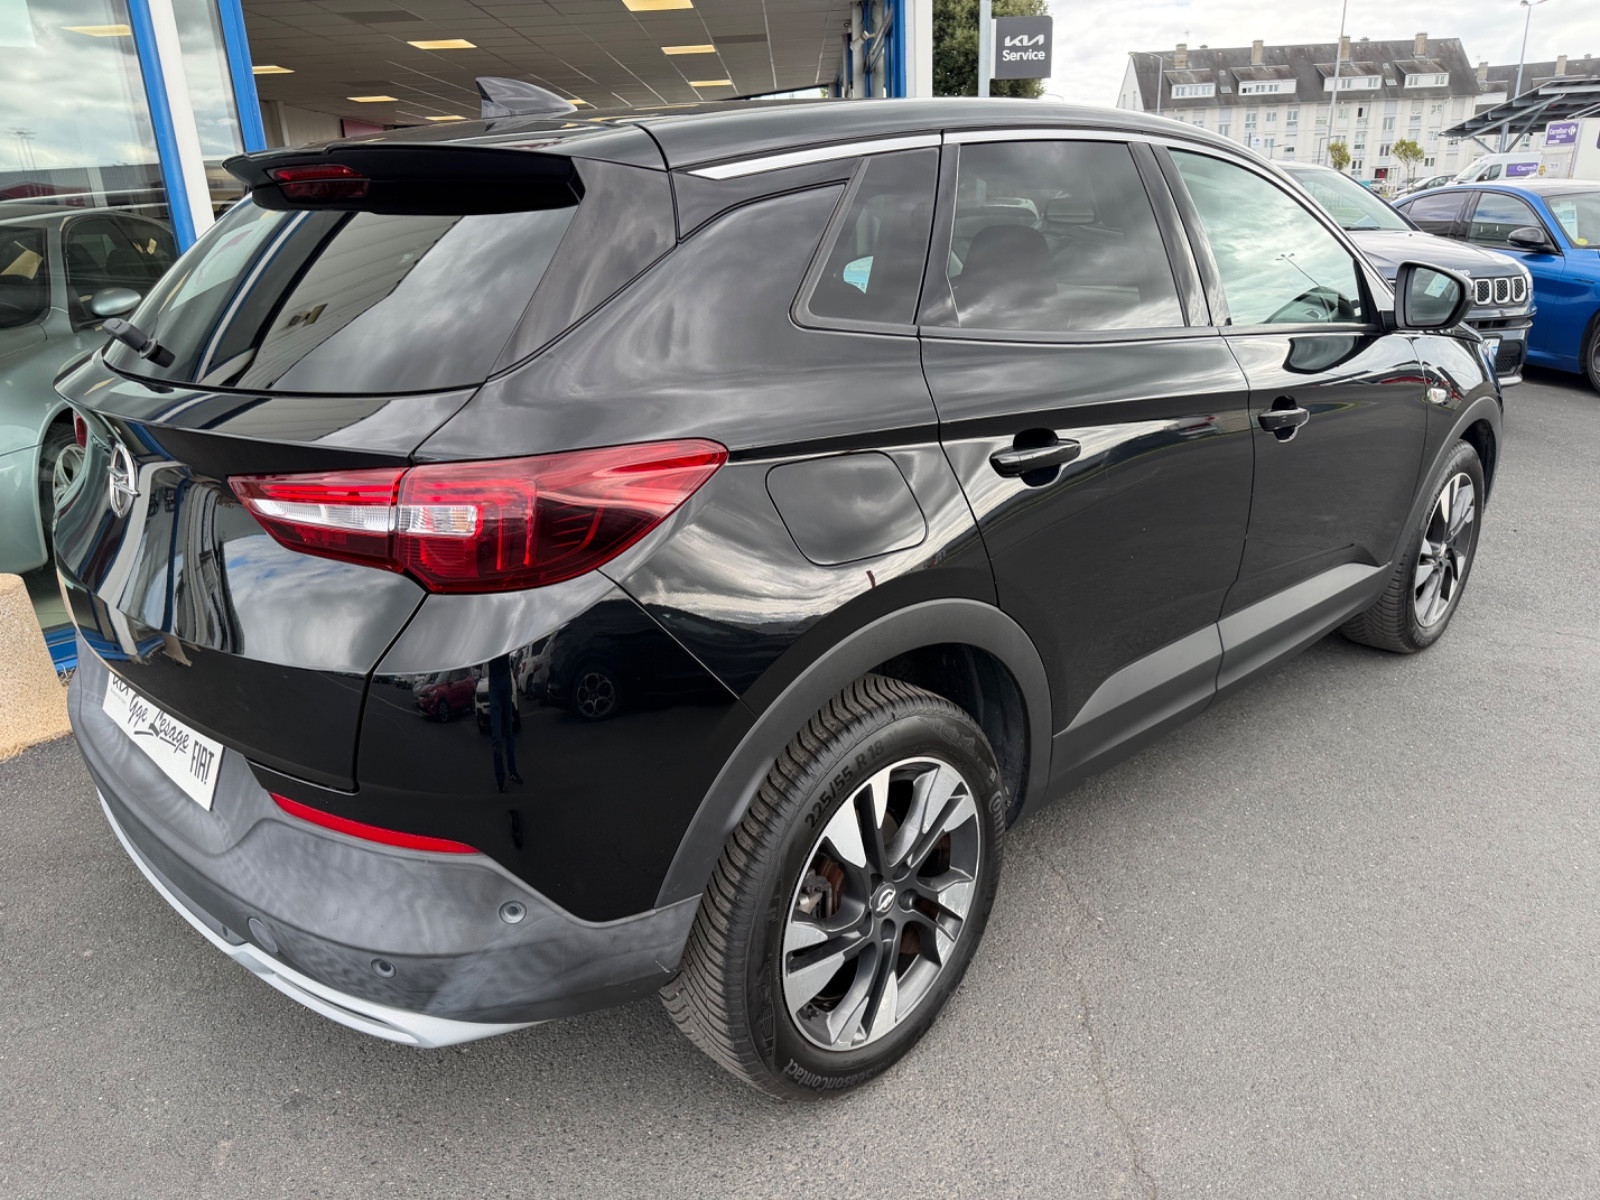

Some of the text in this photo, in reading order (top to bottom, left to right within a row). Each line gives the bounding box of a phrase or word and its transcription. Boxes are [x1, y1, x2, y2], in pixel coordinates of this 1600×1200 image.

[1002, 48, 1046, 62] Service
[1004, 34, 1045, 47] KIA
[189, 739, 215, 785] FIAT
[804, 740, 885, 829] 225/55 R 18
